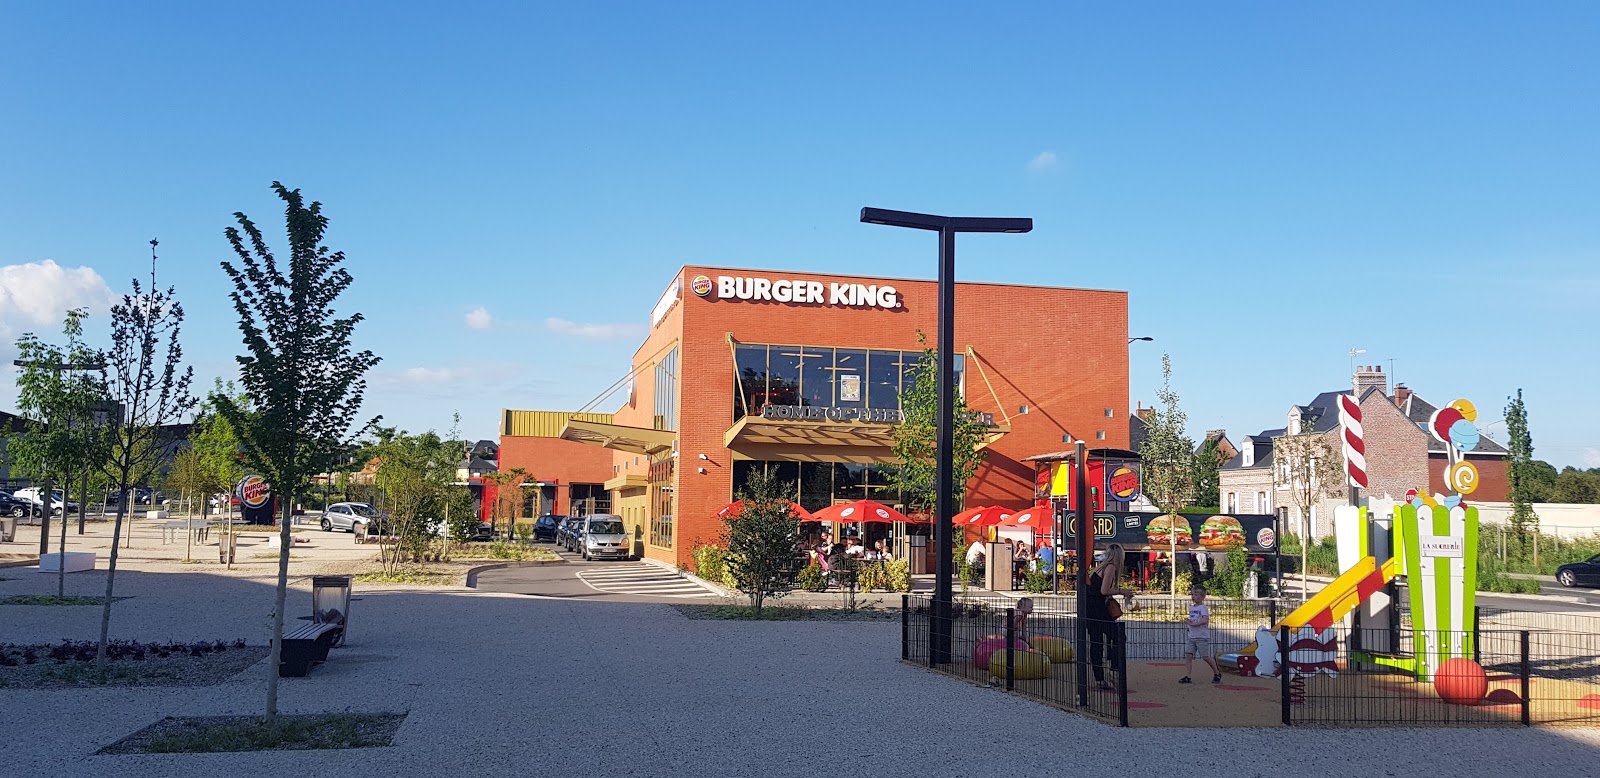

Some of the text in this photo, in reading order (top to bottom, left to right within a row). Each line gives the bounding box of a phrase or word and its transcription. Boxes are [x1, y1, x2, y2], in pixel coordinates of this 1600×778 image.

[694, 283, 710, 291] KING
[717, 275, 824, 304] BURGER
[763, 404, 827, 420] HOME
[825, 406, 852, 421] OF
[854, 407, 900, 423] THE
[244, 489, 263, 501] KIN
[1111, 479, 1137, 495] KING
